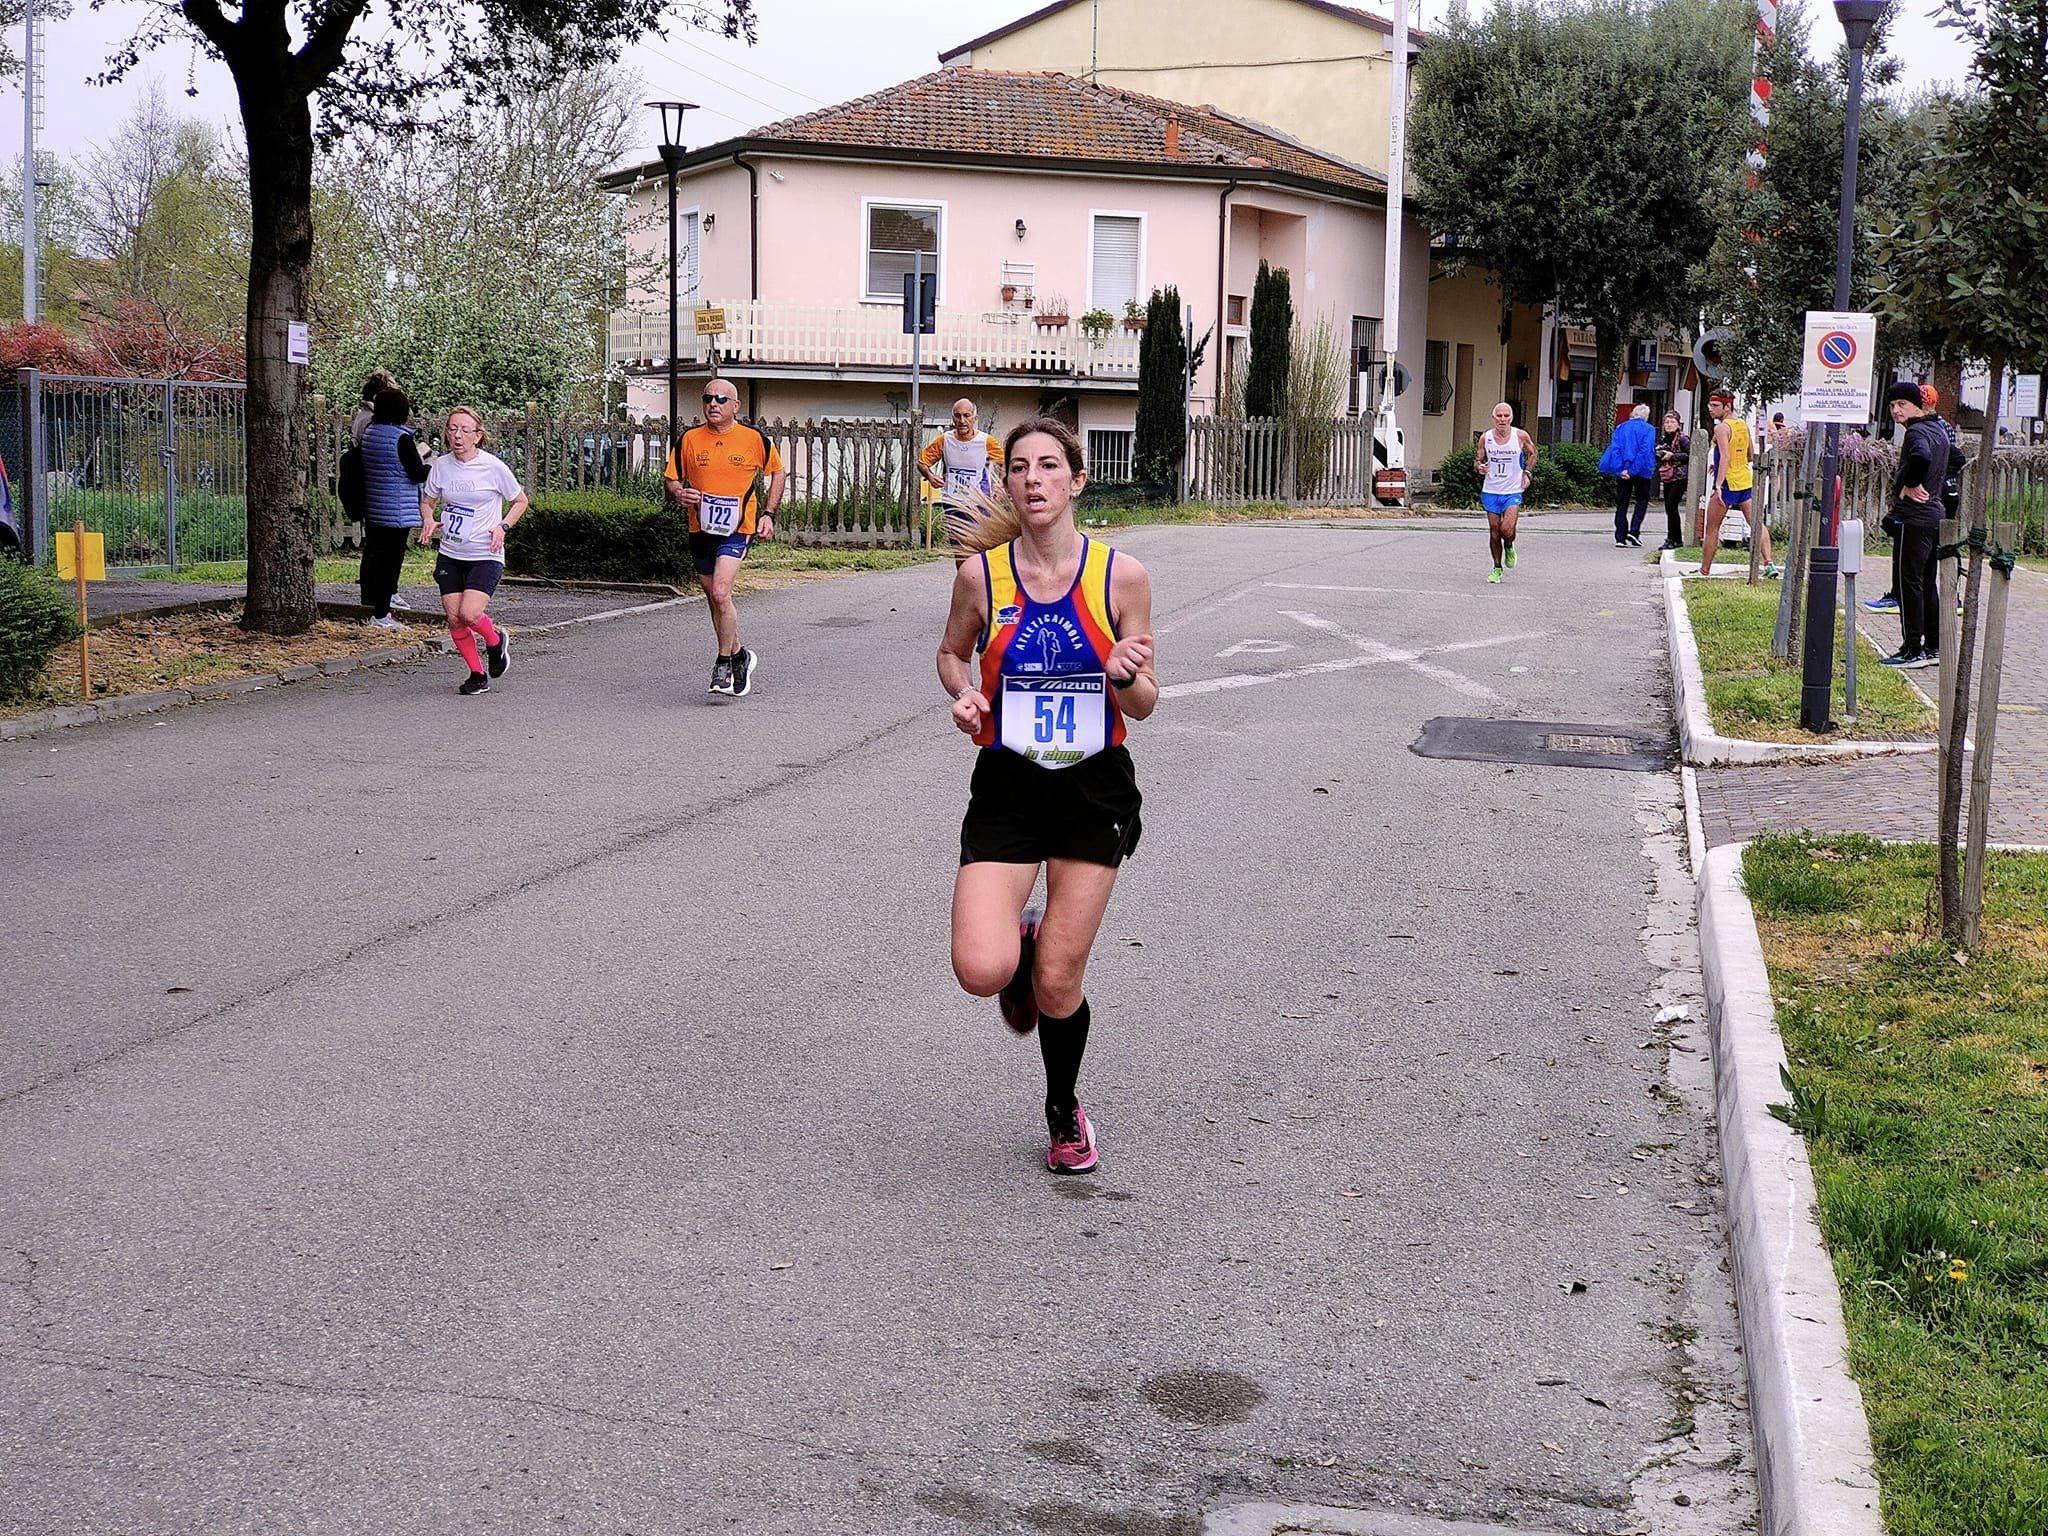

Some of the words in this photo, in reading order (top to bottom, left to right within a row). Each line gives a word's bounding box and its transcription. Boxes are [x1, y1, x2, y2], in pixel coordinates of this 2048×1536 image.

[1498, 464, 1505, 474] 17
[448, 514, 464, 535] 22
[708, 505, 732, 527] 122
[1040, 680, 1101, 691] MIZUNO
[1034, 695, 1077, 744] 54
